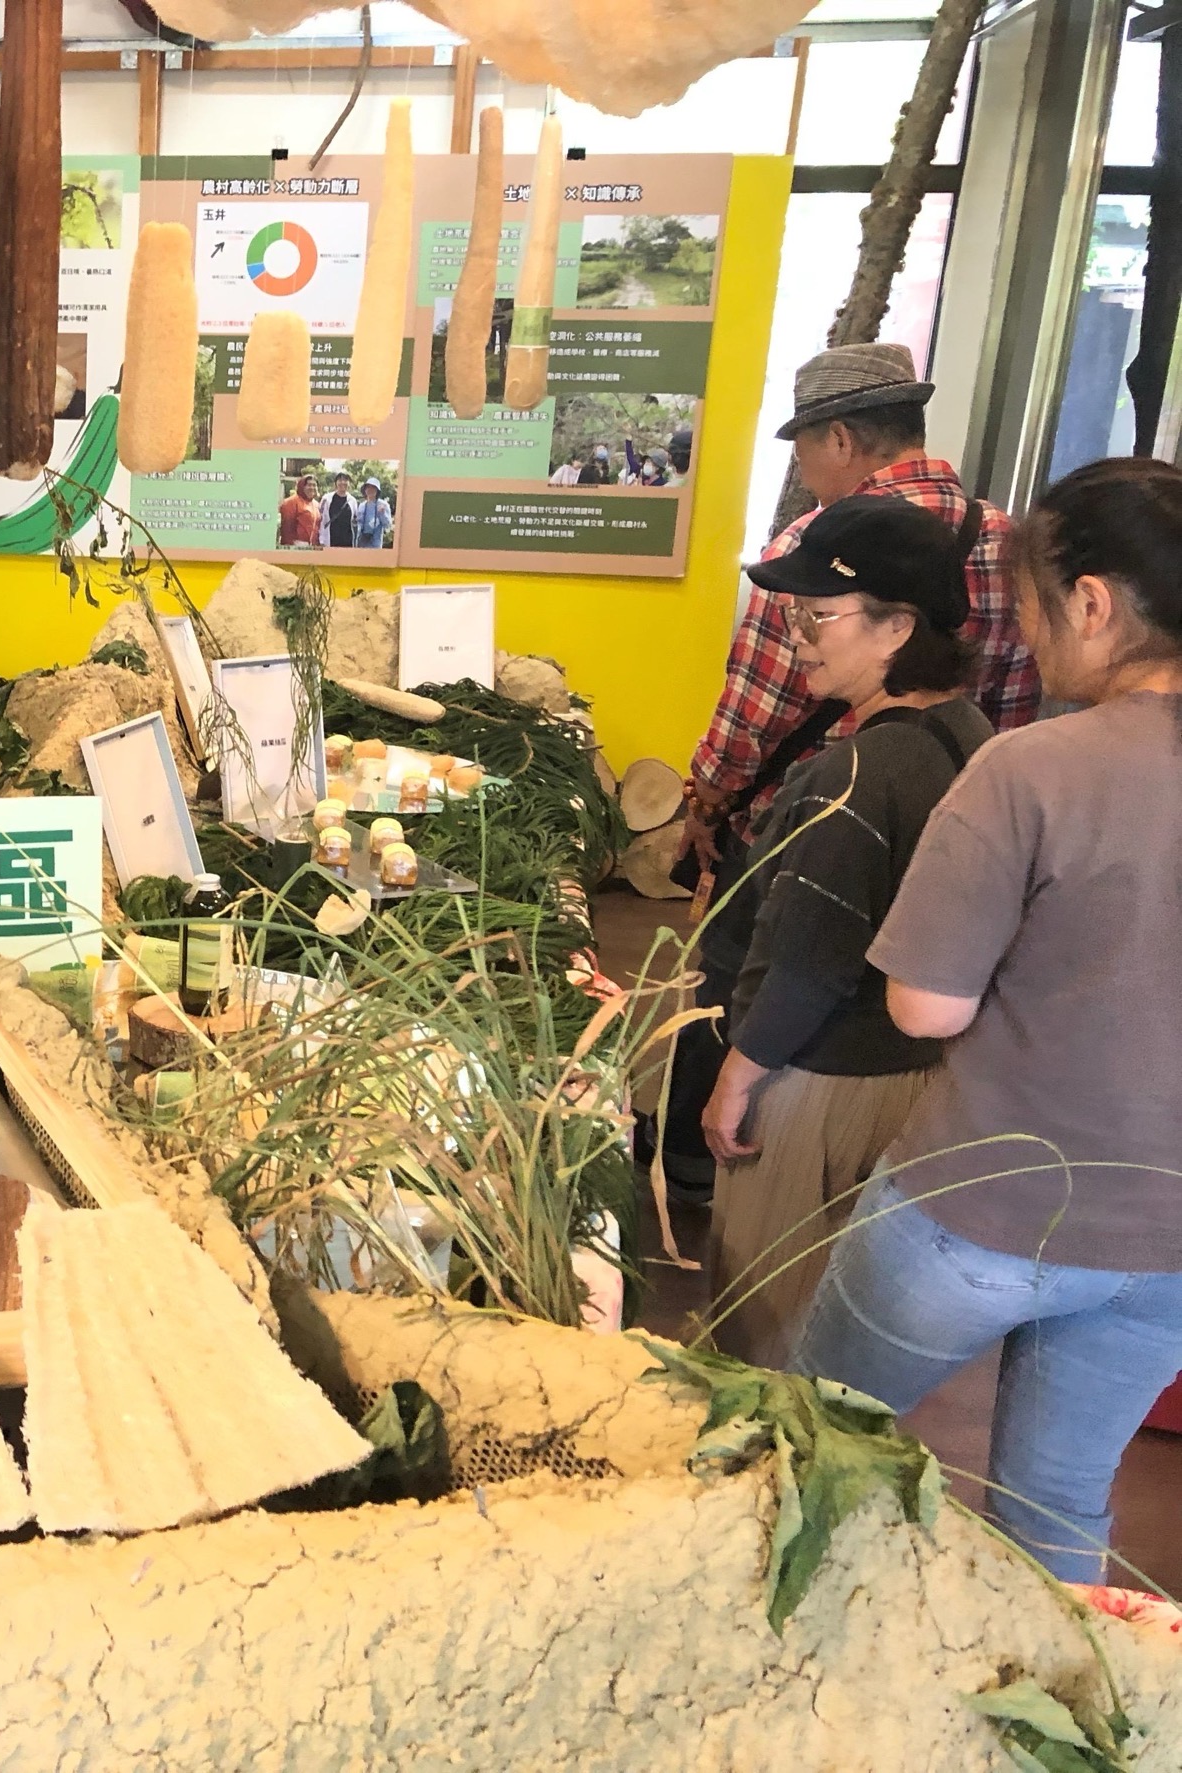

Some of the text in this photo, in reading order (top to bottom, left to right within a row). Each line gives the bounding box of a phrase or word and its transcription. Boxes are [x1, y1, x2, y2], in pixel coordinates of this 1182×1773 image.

[202, 179, 270, 196] 農村高齡化
[288, 179, 359, 196] 勞動力斷層
[503, 184, 531, 202] 土地
[581, 184, 644, 203] 知識傳承
[203, 209, 226, 221] 玉井
